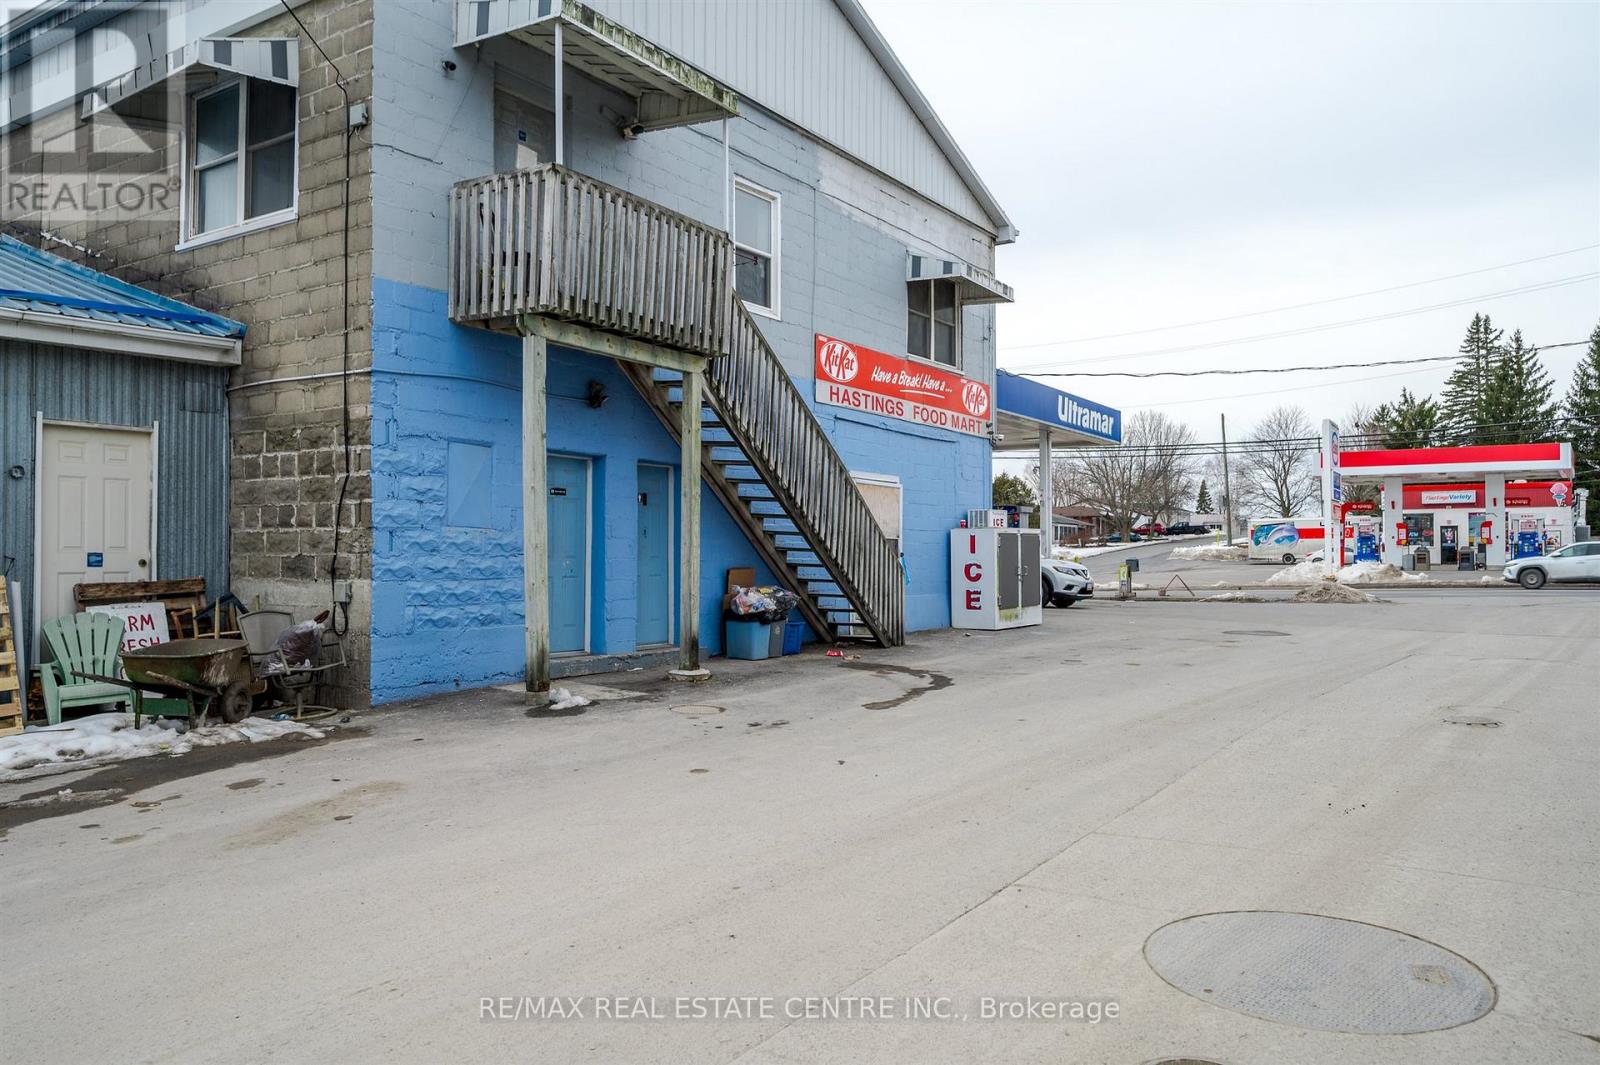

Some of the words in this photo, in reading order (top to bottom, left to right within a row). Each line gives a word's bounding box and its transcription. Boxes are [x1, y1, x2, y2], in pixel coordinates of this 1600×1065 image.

[871, 365, 892, 383] Have
[892, 372, 898, 384] a
[898, 370, 924, 388] Break!
[922, 374, 940, 391] Have
[829, 385, 904, 417] HASTINGS
[913, 405, 947, 426] FOOD
[951, 414, 982, 434] MART
[1057, 394, 1115, 437] Ultramar
[992, 518, 1005, 527] ICE
[126, 613, 155, 632] RM
